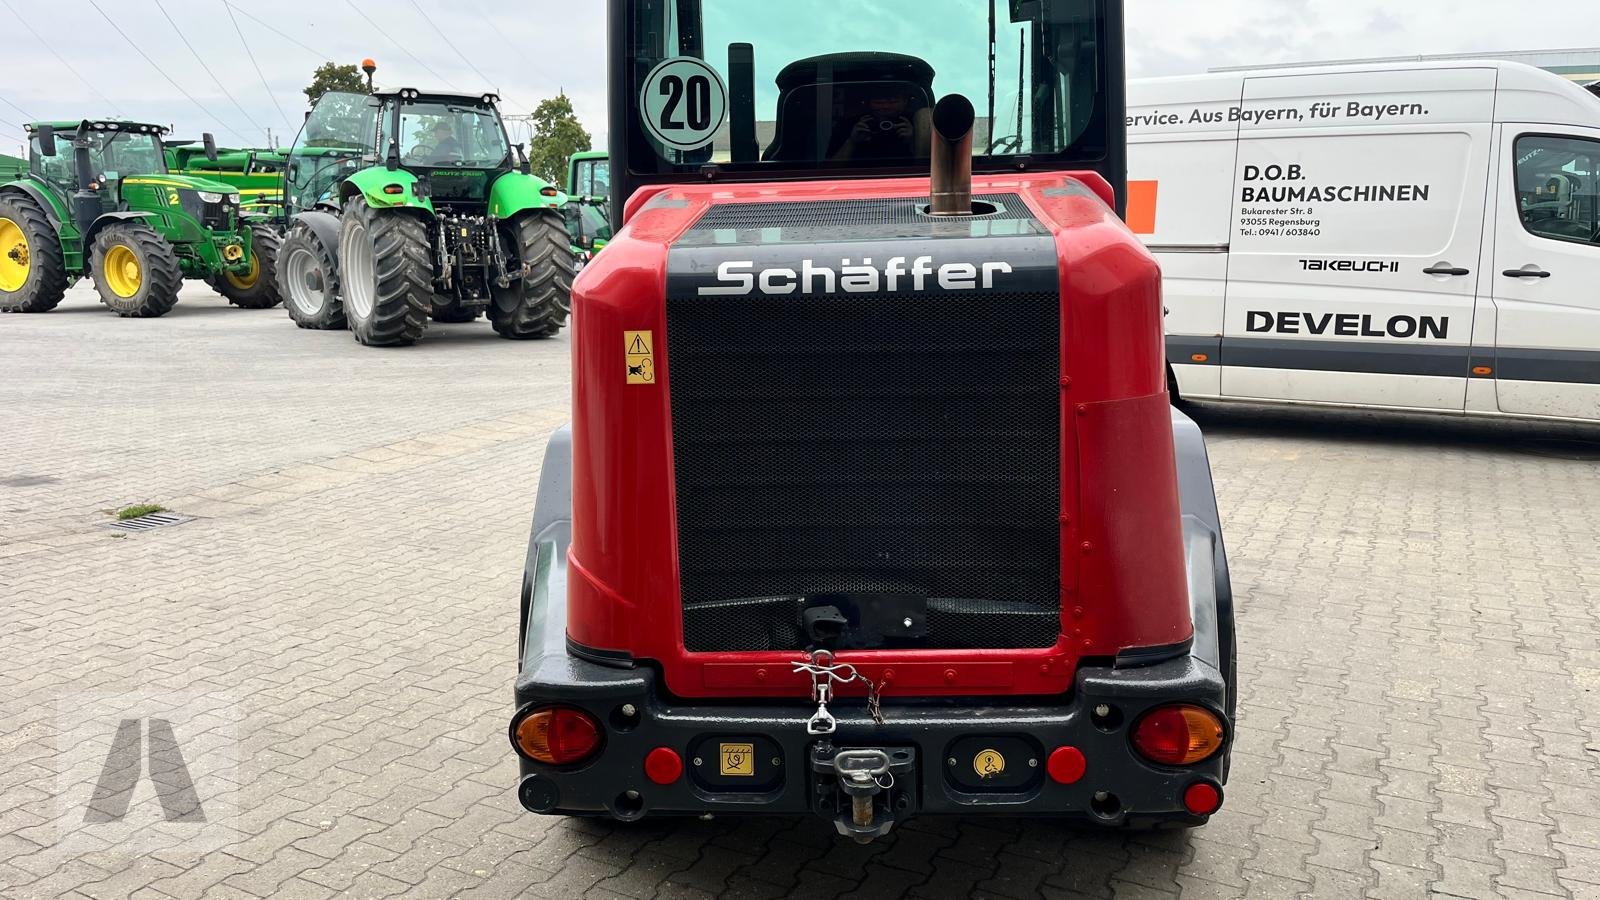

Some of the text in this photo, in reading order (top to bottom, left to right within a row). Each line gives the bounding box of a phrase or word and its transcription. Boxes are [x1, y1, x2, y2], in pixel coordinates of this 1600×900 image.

[659, 75, 711, 131] 20
[1125, 101, 1429, 126] ervice. Aus Bayern, für Bayern.
[1243, 164, 1306, 181] D.O.B.
[1241, 185, 1430, 202] BAUMASCHINEN
[1241, 207, 1313, 215] Bukarester Str. 8
[1240, 218, 1320, 227] 93055 Regensburg
[1240, 228, 1257, 236] Tel.:
[1259, 228, 1279, 236] 0941
[1286, 228, 1320, 236] 603840
[1299, 259, 1399, 272] TAKEUCHI
[697, 255, 1013, 295] Schäffer
[1246, 310, 1450, 340] DEVELON
